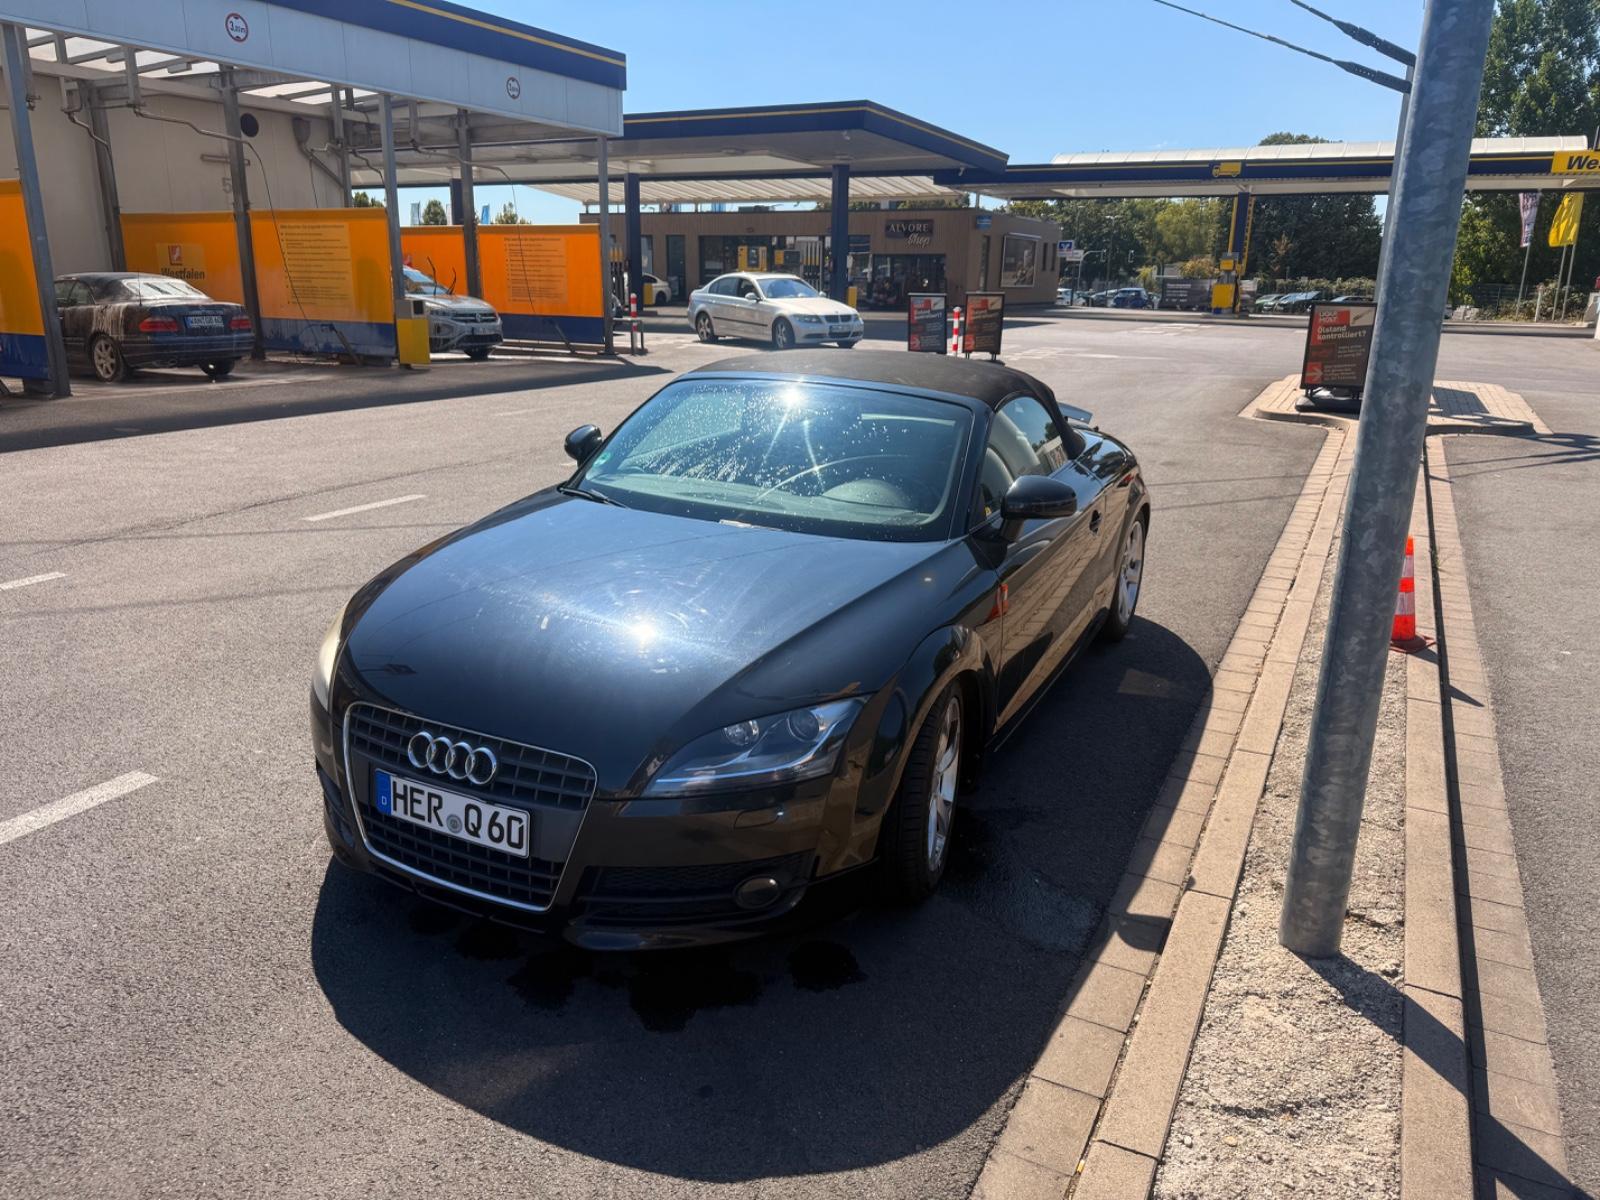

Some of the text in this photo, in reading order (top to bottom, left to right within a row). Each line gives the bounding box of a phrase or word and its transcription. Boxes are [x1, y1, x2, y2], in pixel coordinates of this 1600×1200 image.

[1567, 156, 1600, 169] We
[889, 223, 929, 233] ALVORE
[906, 232, 930, 249] Shop
[1316, 330, 1367, 342] kontrolliert?
[1317, 325, 1347, 335] Ölstand
[392, 780, 444, 828] HER
